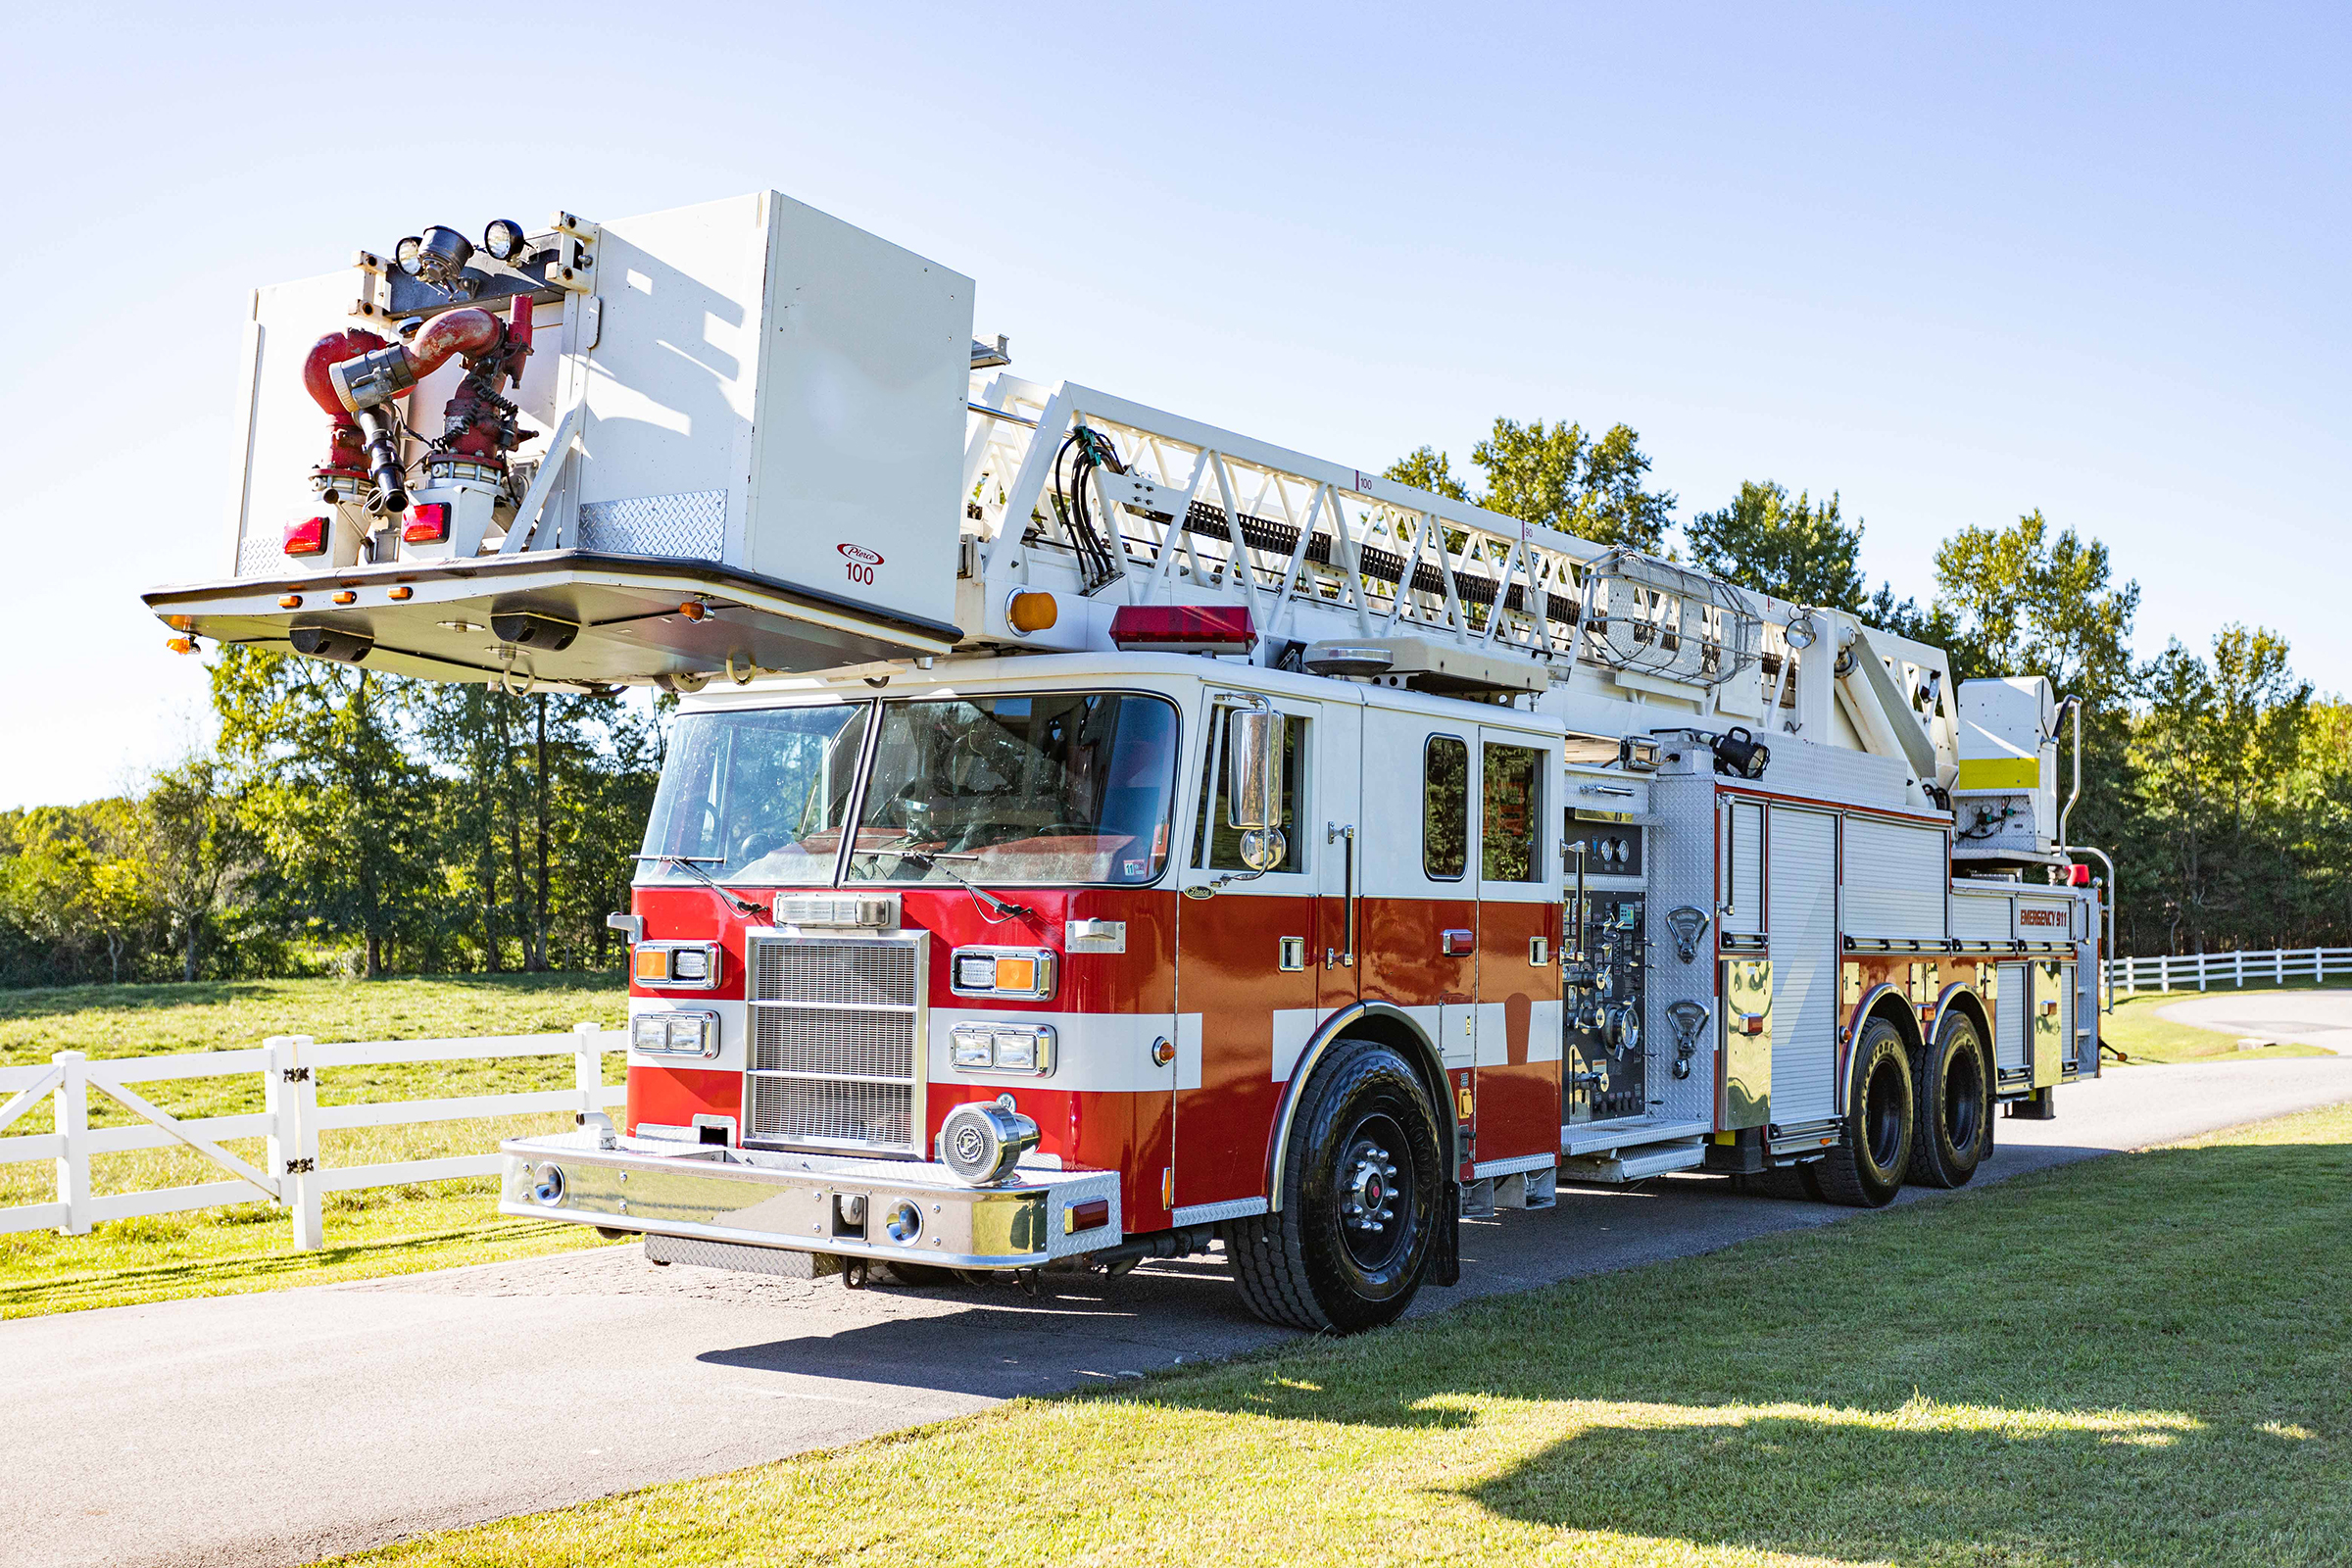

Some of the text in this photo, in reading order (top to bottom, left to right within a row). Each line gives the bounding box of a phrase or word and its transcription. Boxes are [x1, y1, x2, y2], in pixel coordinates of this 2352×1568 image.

[1360, 477, 1372, 490] 100
[848, 546, 875, 561] Pierce
[846, 562, 874, 586] 100
[1126, 863, 1134, 874] 11
[2020, 909, 2067, 927] EMERGENCY 911
